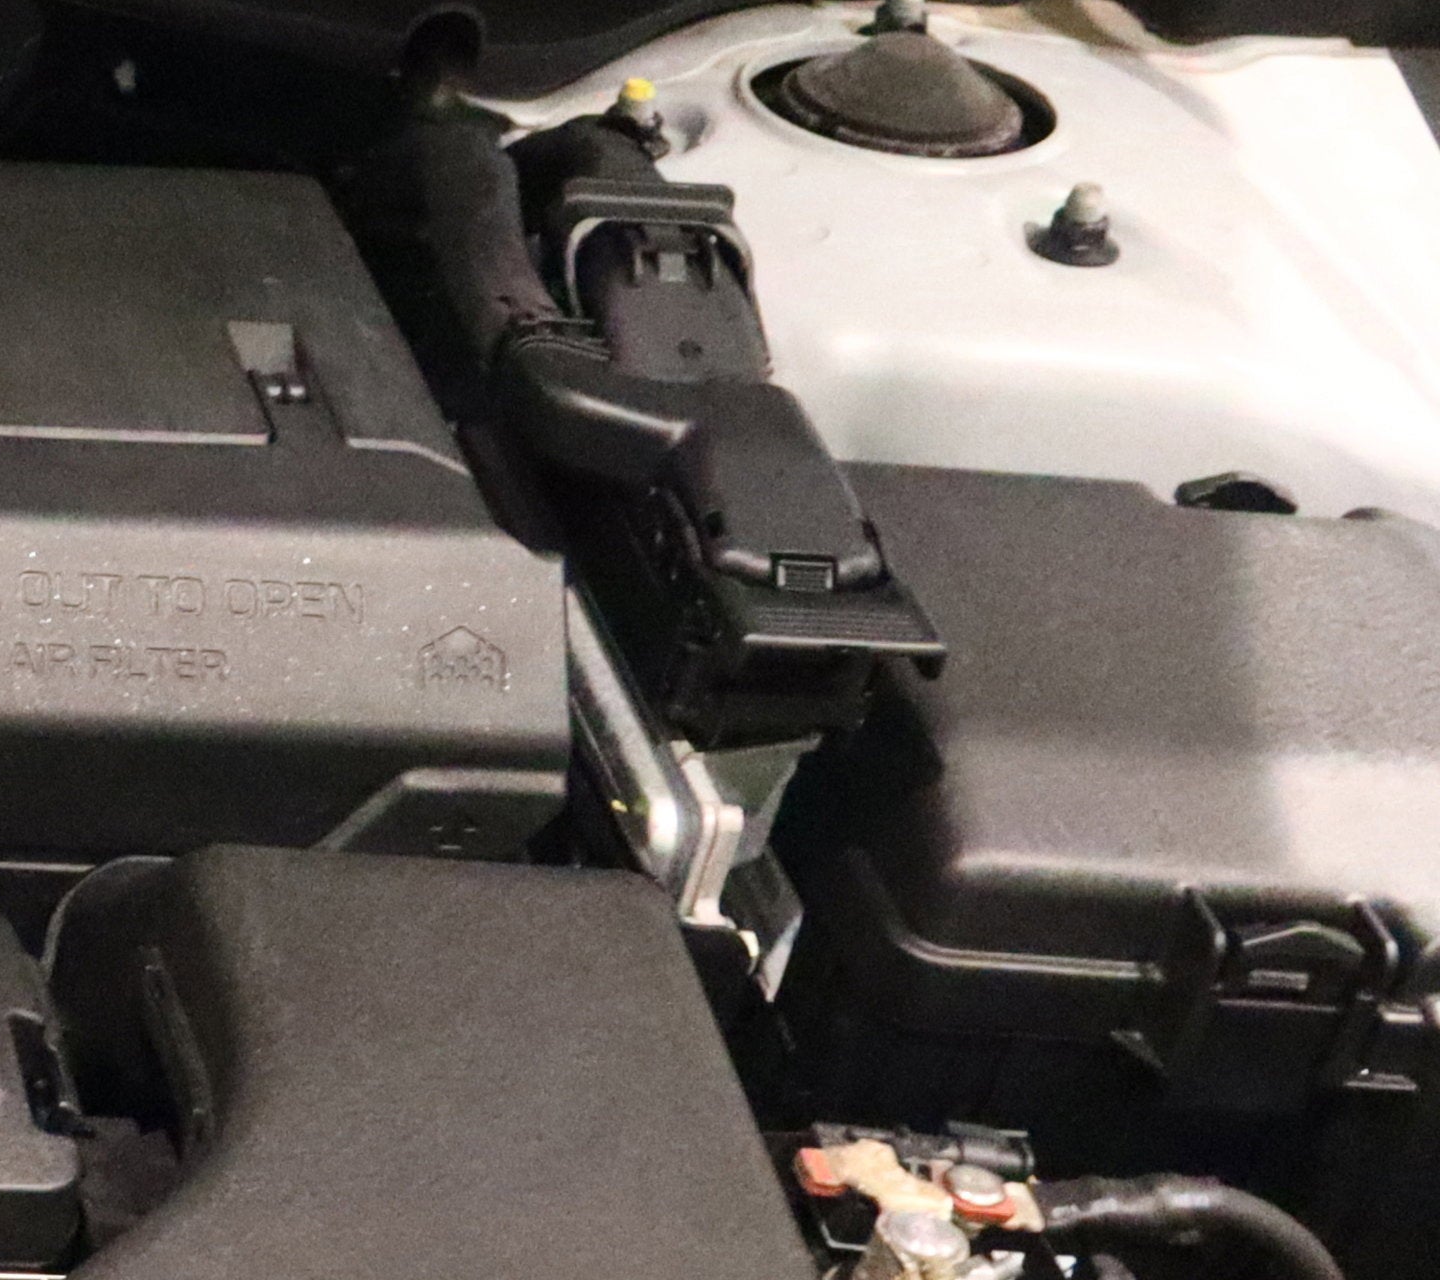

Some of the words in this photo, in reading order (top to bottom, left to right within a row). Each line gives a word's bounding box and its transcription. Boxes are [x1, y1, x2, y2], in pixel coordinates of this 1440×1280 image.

[18, 569, 123, 618] OUT
[137, 575, 205, 618] TO
[224, 577, 365, 625] OPEN
[9, 641, 77, 676] AIR
[88, 644, 229, 682] FILTER
